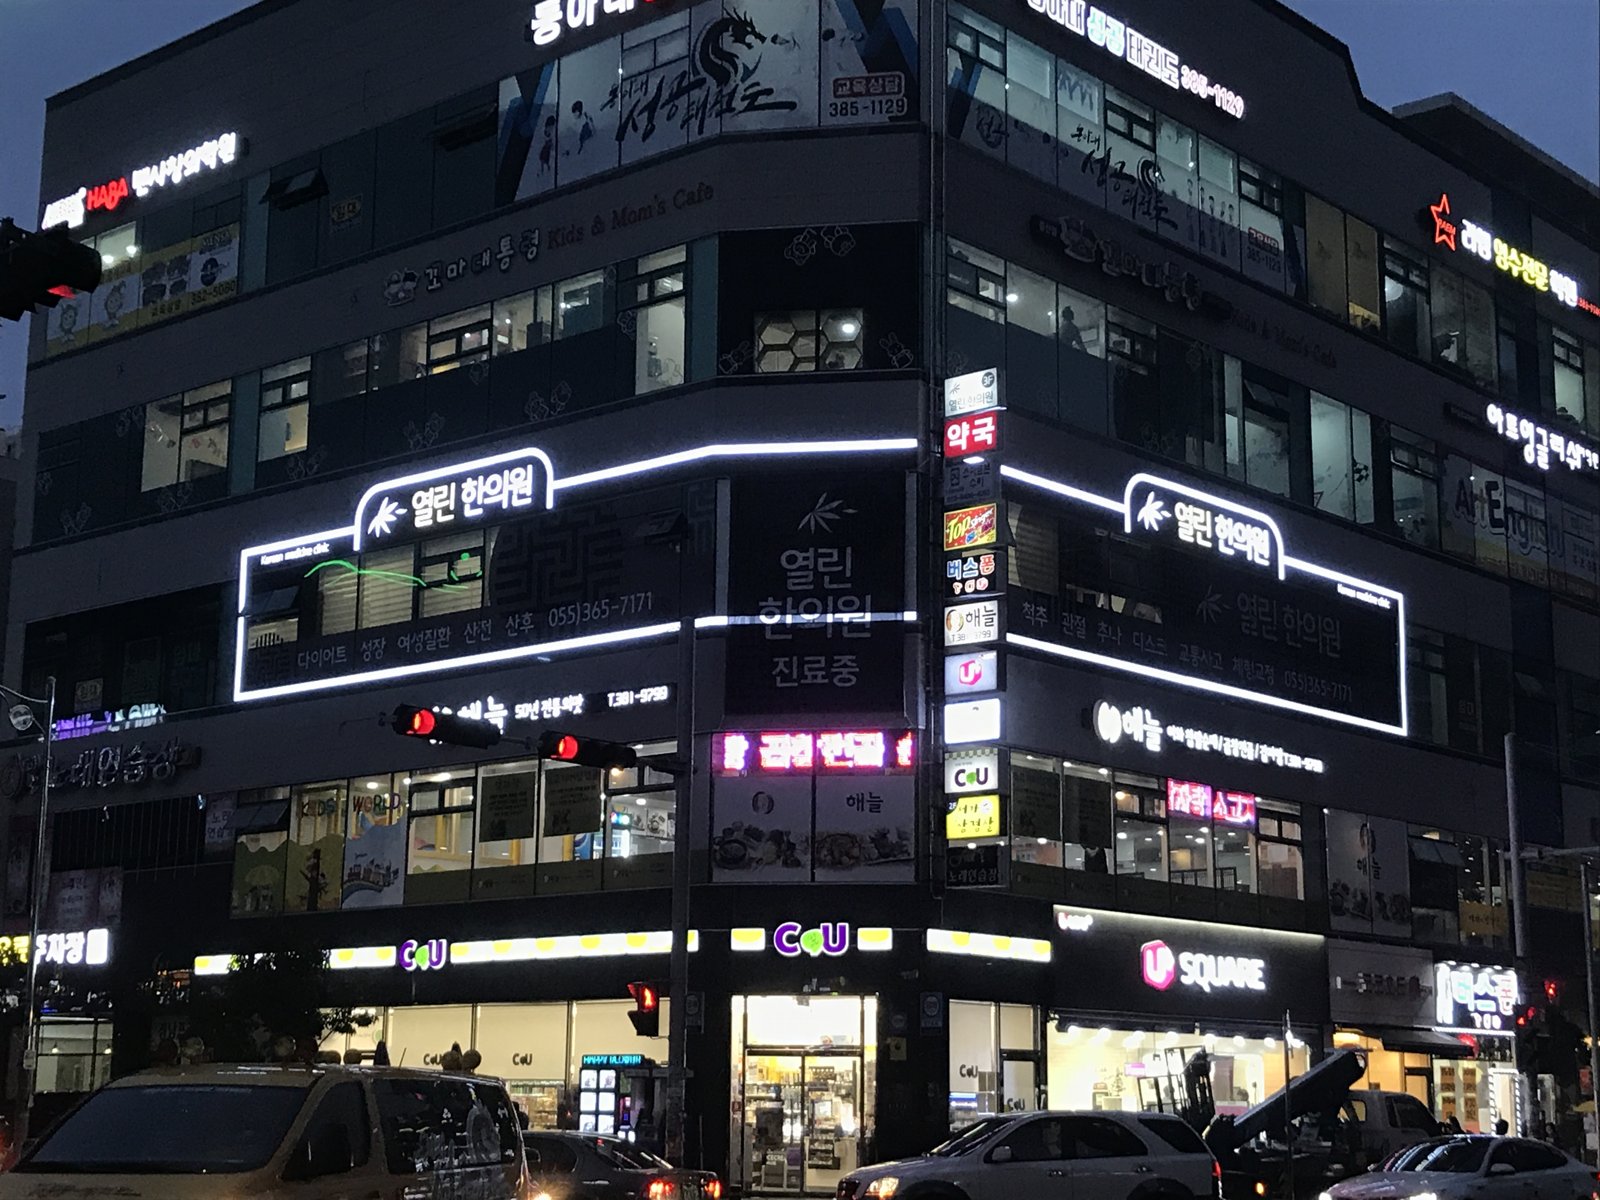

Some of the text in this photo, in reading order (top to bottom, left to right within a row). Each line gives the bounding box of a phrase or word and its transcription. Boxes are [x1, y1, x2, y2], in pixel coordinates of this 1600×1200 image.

[1087, 6, 1126, 57] 성공
[1126, 27, 1179, 90] 태권도
[1180, 64, 1244, 119] 385-1129
[834, 76, 903, 97] 교육상담
[829, 98, 907, 118] 385-1129
[87, 176, 129, 211] HABA
[547, 226, 585, 250] Kids
[589, 215, 606, 236] &
[612, 196, 667, 231] Mom's
[673, 182, 715, 211] Cafe
[982, 373, 995, 387] 3F
[947, 416, 995, 451] 약국
[411, 463, 533, 528] 열린 한의원
[947, 514, 971, 543] Top
[1174, 501, 1271, 567] 열린 한의원
[779, 545, 853, 592] 열린
[946, 554, 995, 581] 버스폰
[297, 591, 652, 670] 다이어트 성장 여성질환 산전 산후 055)365-7171
[758, 593, 873, 641] 한의원
[966, 605, 997, 628] 해늘
[1060, 611, 1088, 640] 관절
[1132, 631, 1168, 657] 디스크
[1236, 591, 1342, 659] 열린 한의원
[771, 654, 860, 689] 진료중
[1121, 705, 1164, 752] 해늘
[954, 766, 989, 788] CU
[353, 791, 401, 815] WORLD
[845, 791, 884, 814] 해늘
[397, 937, 448, 971] CU
[772, 921, 851, 959] CU
[1178, 950, 1267, 993] SQUARE
[1450, 970, 1518, 1016] 버스폰
[511, 1052, 534, 1067] CU
[959, 1063, 979, 1079] CU
